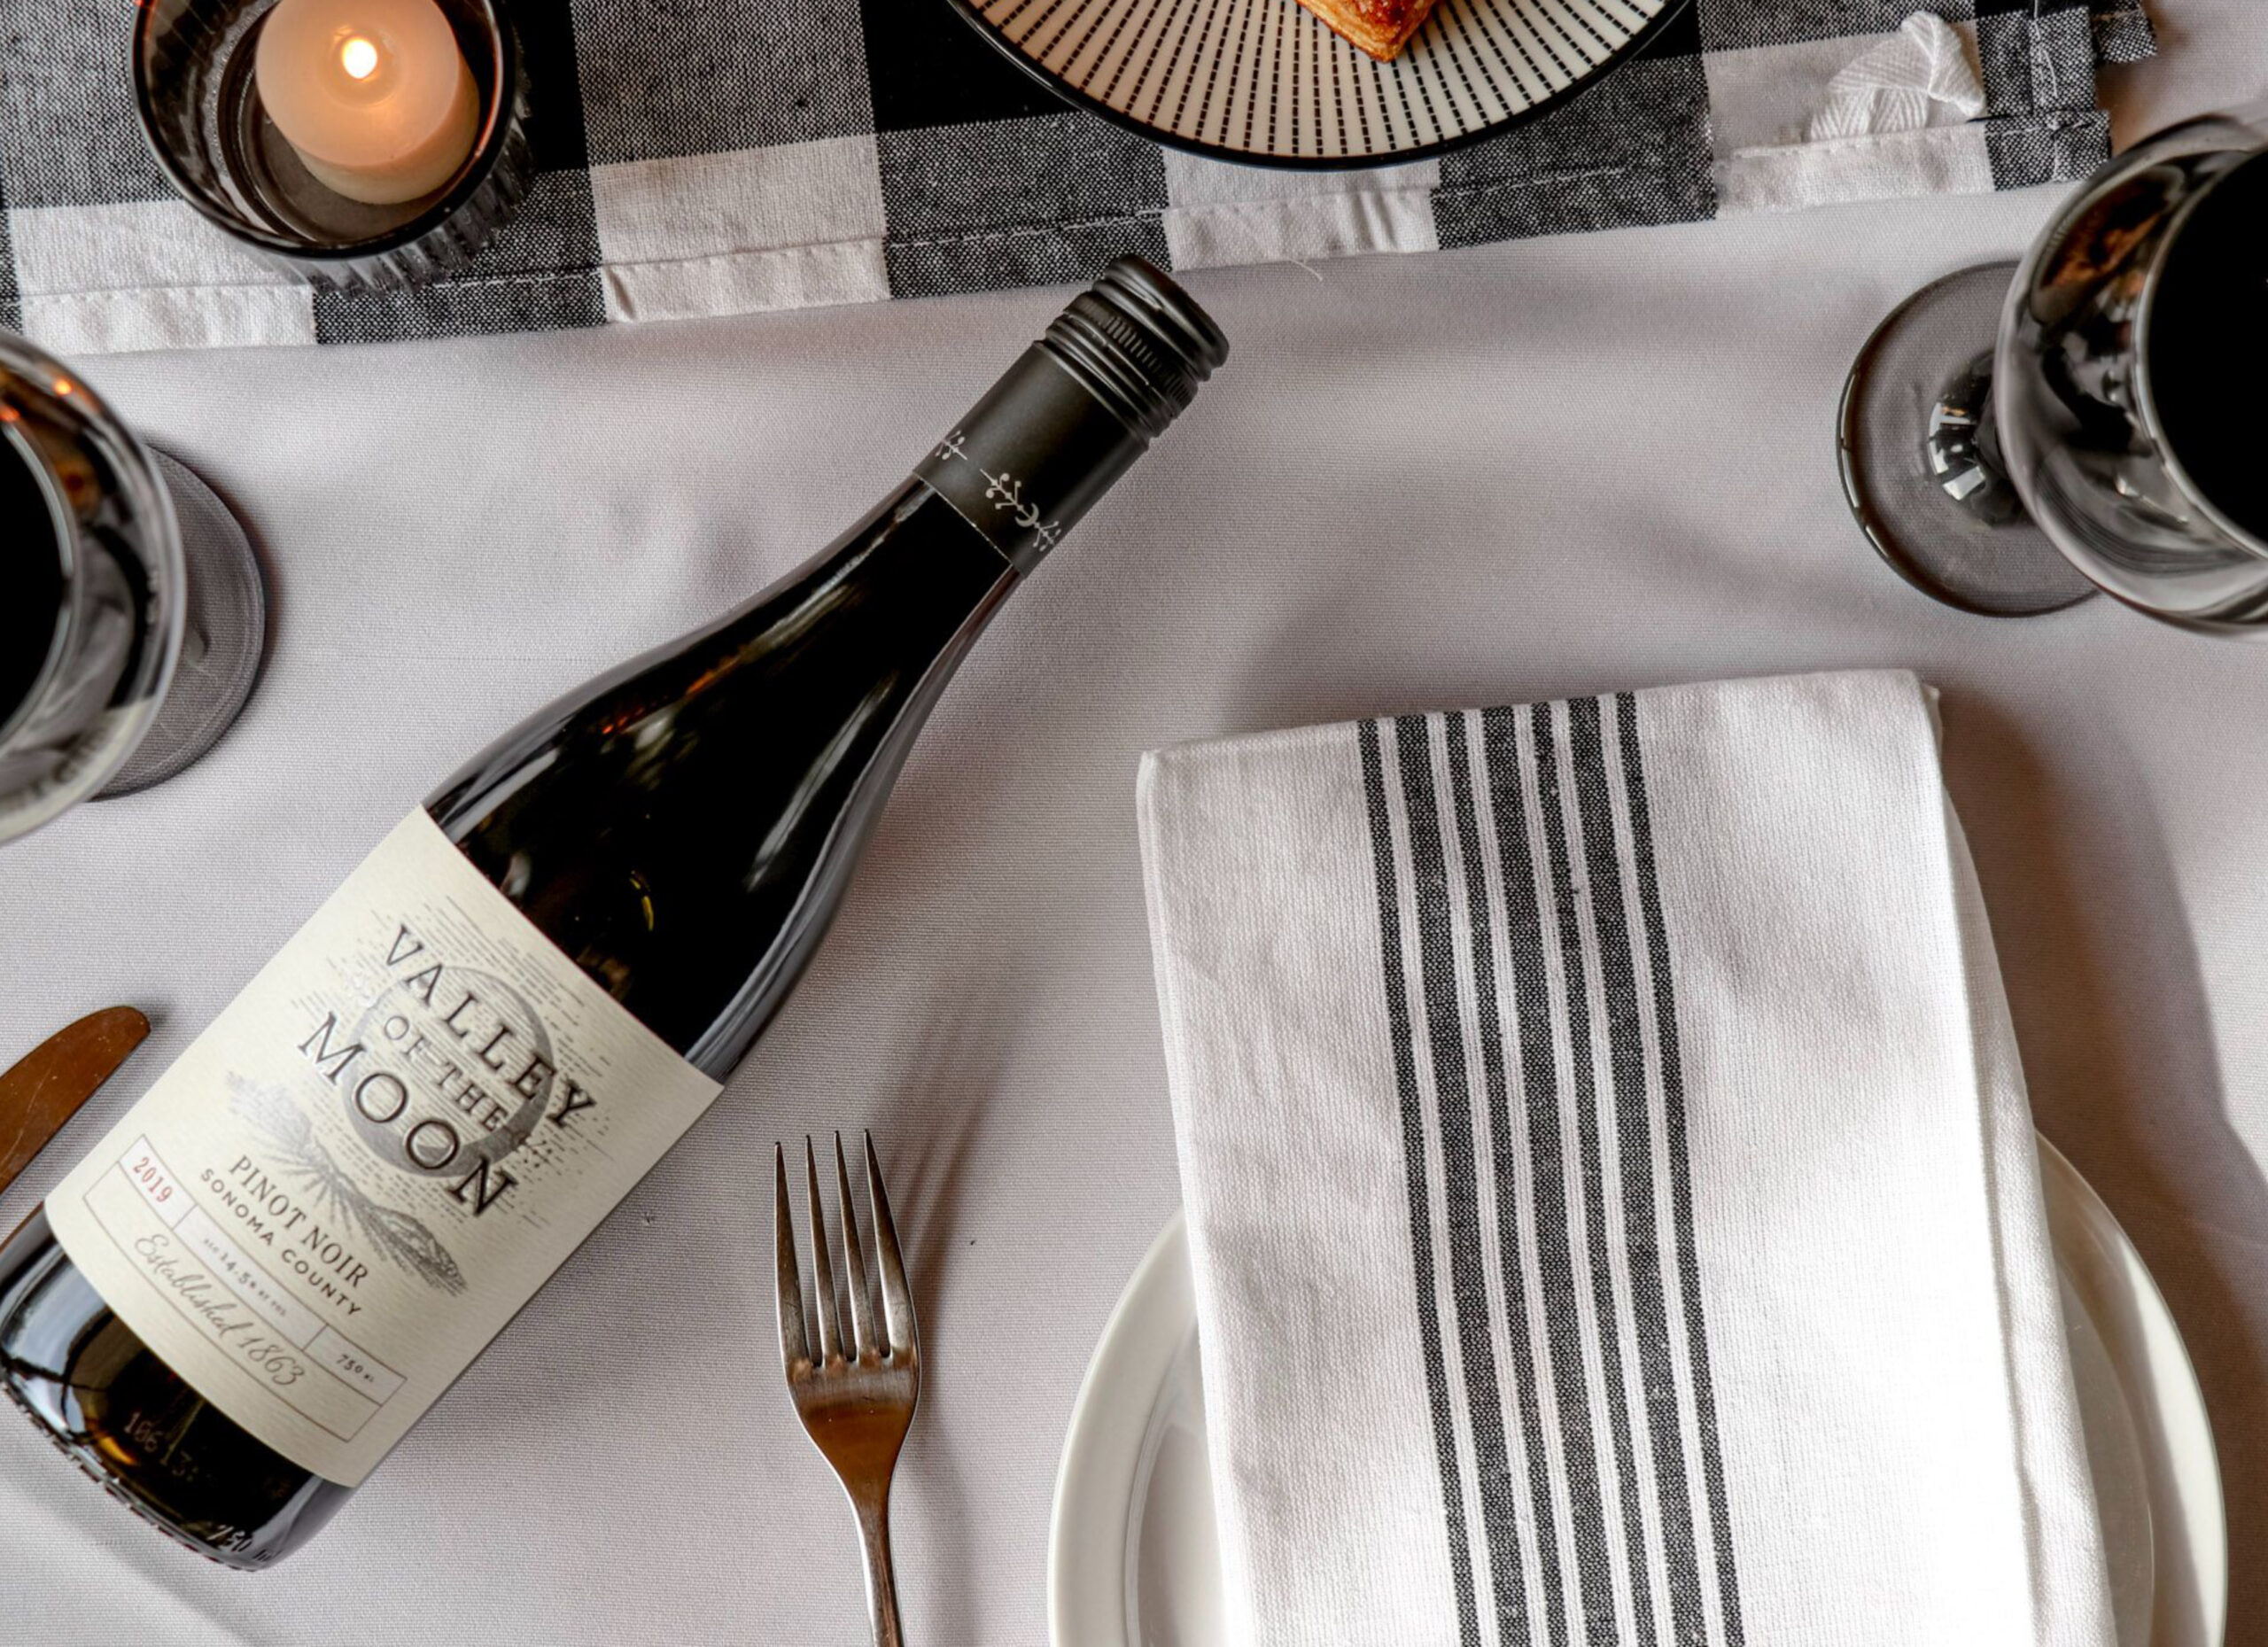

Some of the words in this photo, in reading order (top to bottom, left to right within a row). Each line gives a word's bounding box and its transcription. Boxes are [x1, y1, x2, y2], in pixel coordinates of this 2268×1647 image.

[384, 1015, 432, 1056] OF
[436, 1062, 509, 1131] THE
[386, 923, 596, 1128] VALLEY
[133, 1156, 173, 1203] 2019
[298, 1011, 517, 1217] MOON
[200, 1168, 275, 1247] SONOMA
[281, 1248, 361, 1316] COUNTY
[228, 1155, 307, 1230] PINOT
[301, 1225, 369, 1288] NOIR
[134, 1233, 253, 1338] Established
[237, 1337, 306, 1386] 1863
[335, 1354, 364, 1374] 750
